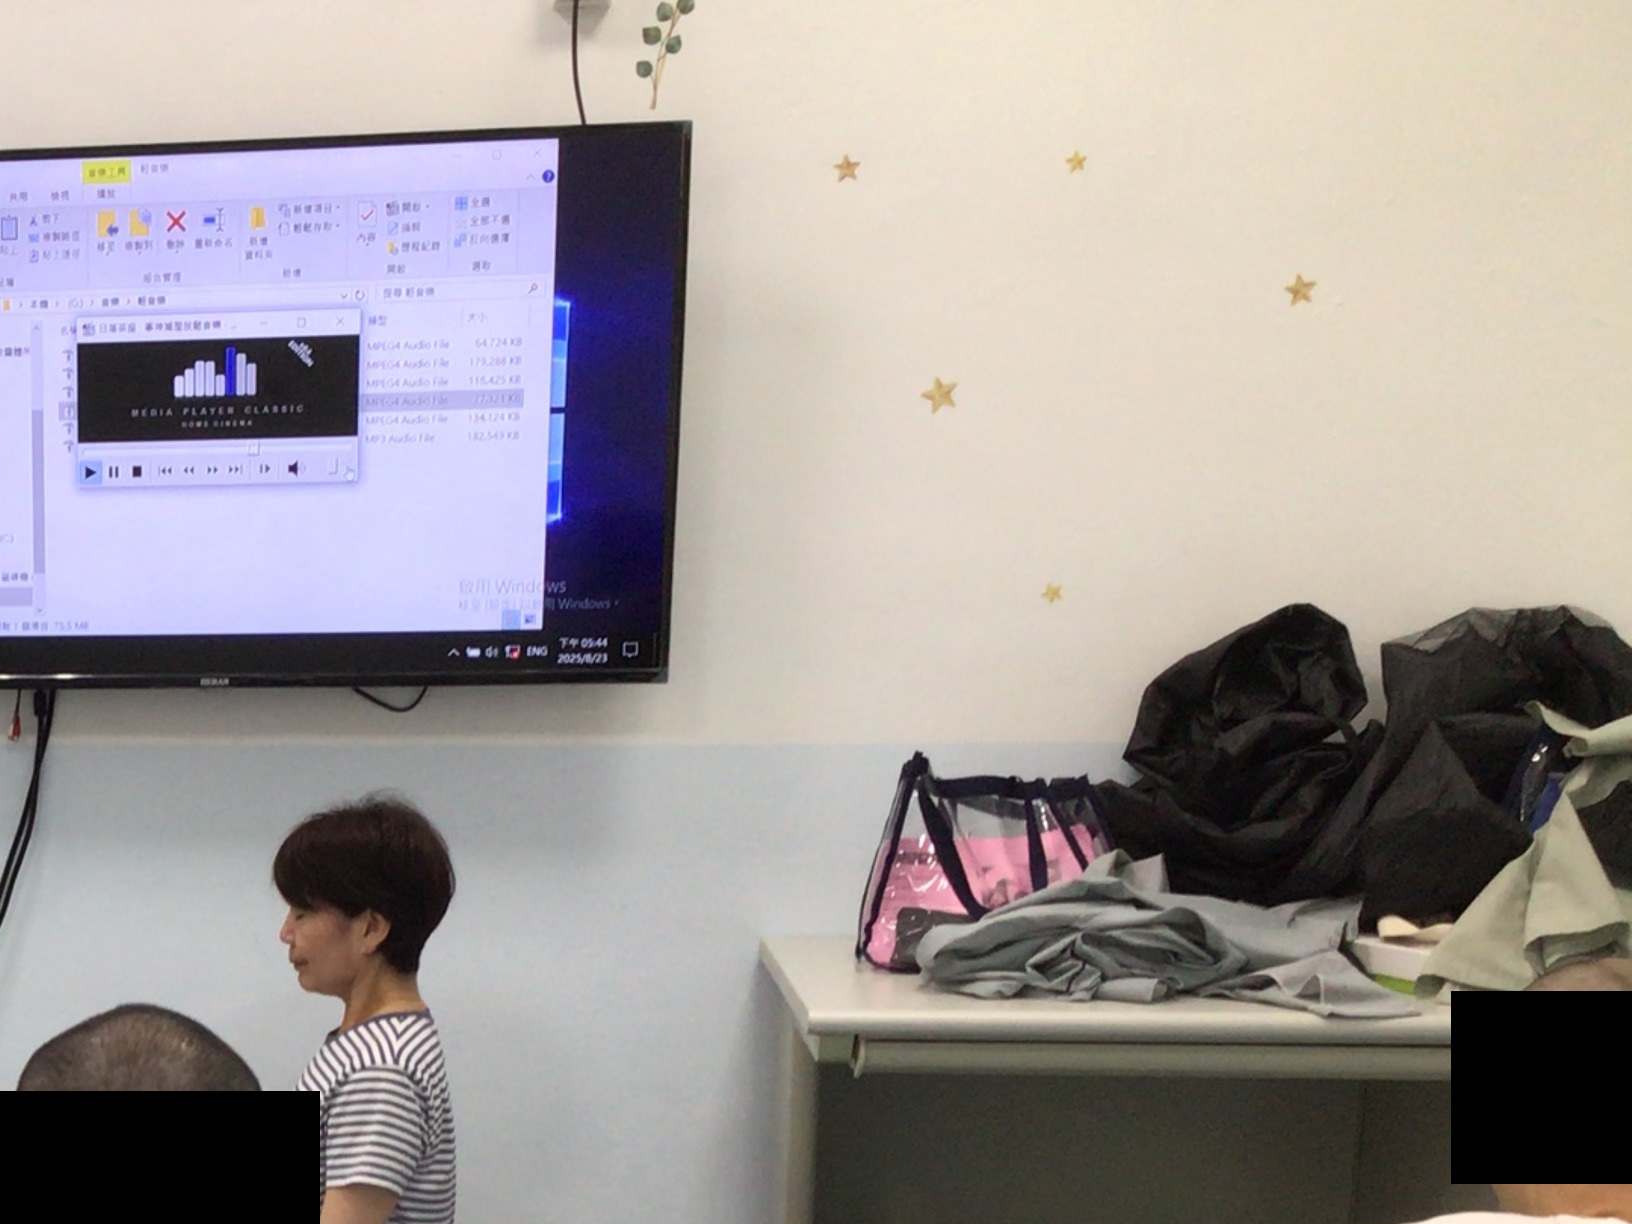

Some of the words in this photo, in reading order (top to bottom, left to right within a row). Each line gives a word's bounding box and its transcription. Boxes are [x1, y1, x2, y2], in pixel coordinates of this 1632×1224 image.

[404, 341, 431, 350] Audio
[510, 337, 523, 347] KB
[403, 359, 430, 368] Audio
[509, 356, 522, 365] KB
[403, 377, 430, 387] Audio
[509, 375, 521, 384] KB
[402, 396, 430, 405] Audio
[508, 393, 520, 403] KB
[131, 408, 173, 418] MEDIA
[182, 406, 235, 417] PLAYER
[244, 404, 305, 414] CLASSIC
[402, 414, 429, 424] Audio
[508, 412, 520, 422] KB
[388, 433, 416, 443] Audio
[507, 431, 519, 440] KB
[559, 638, 579, 649] 下午
[527, 646, 548, 657] ENG
